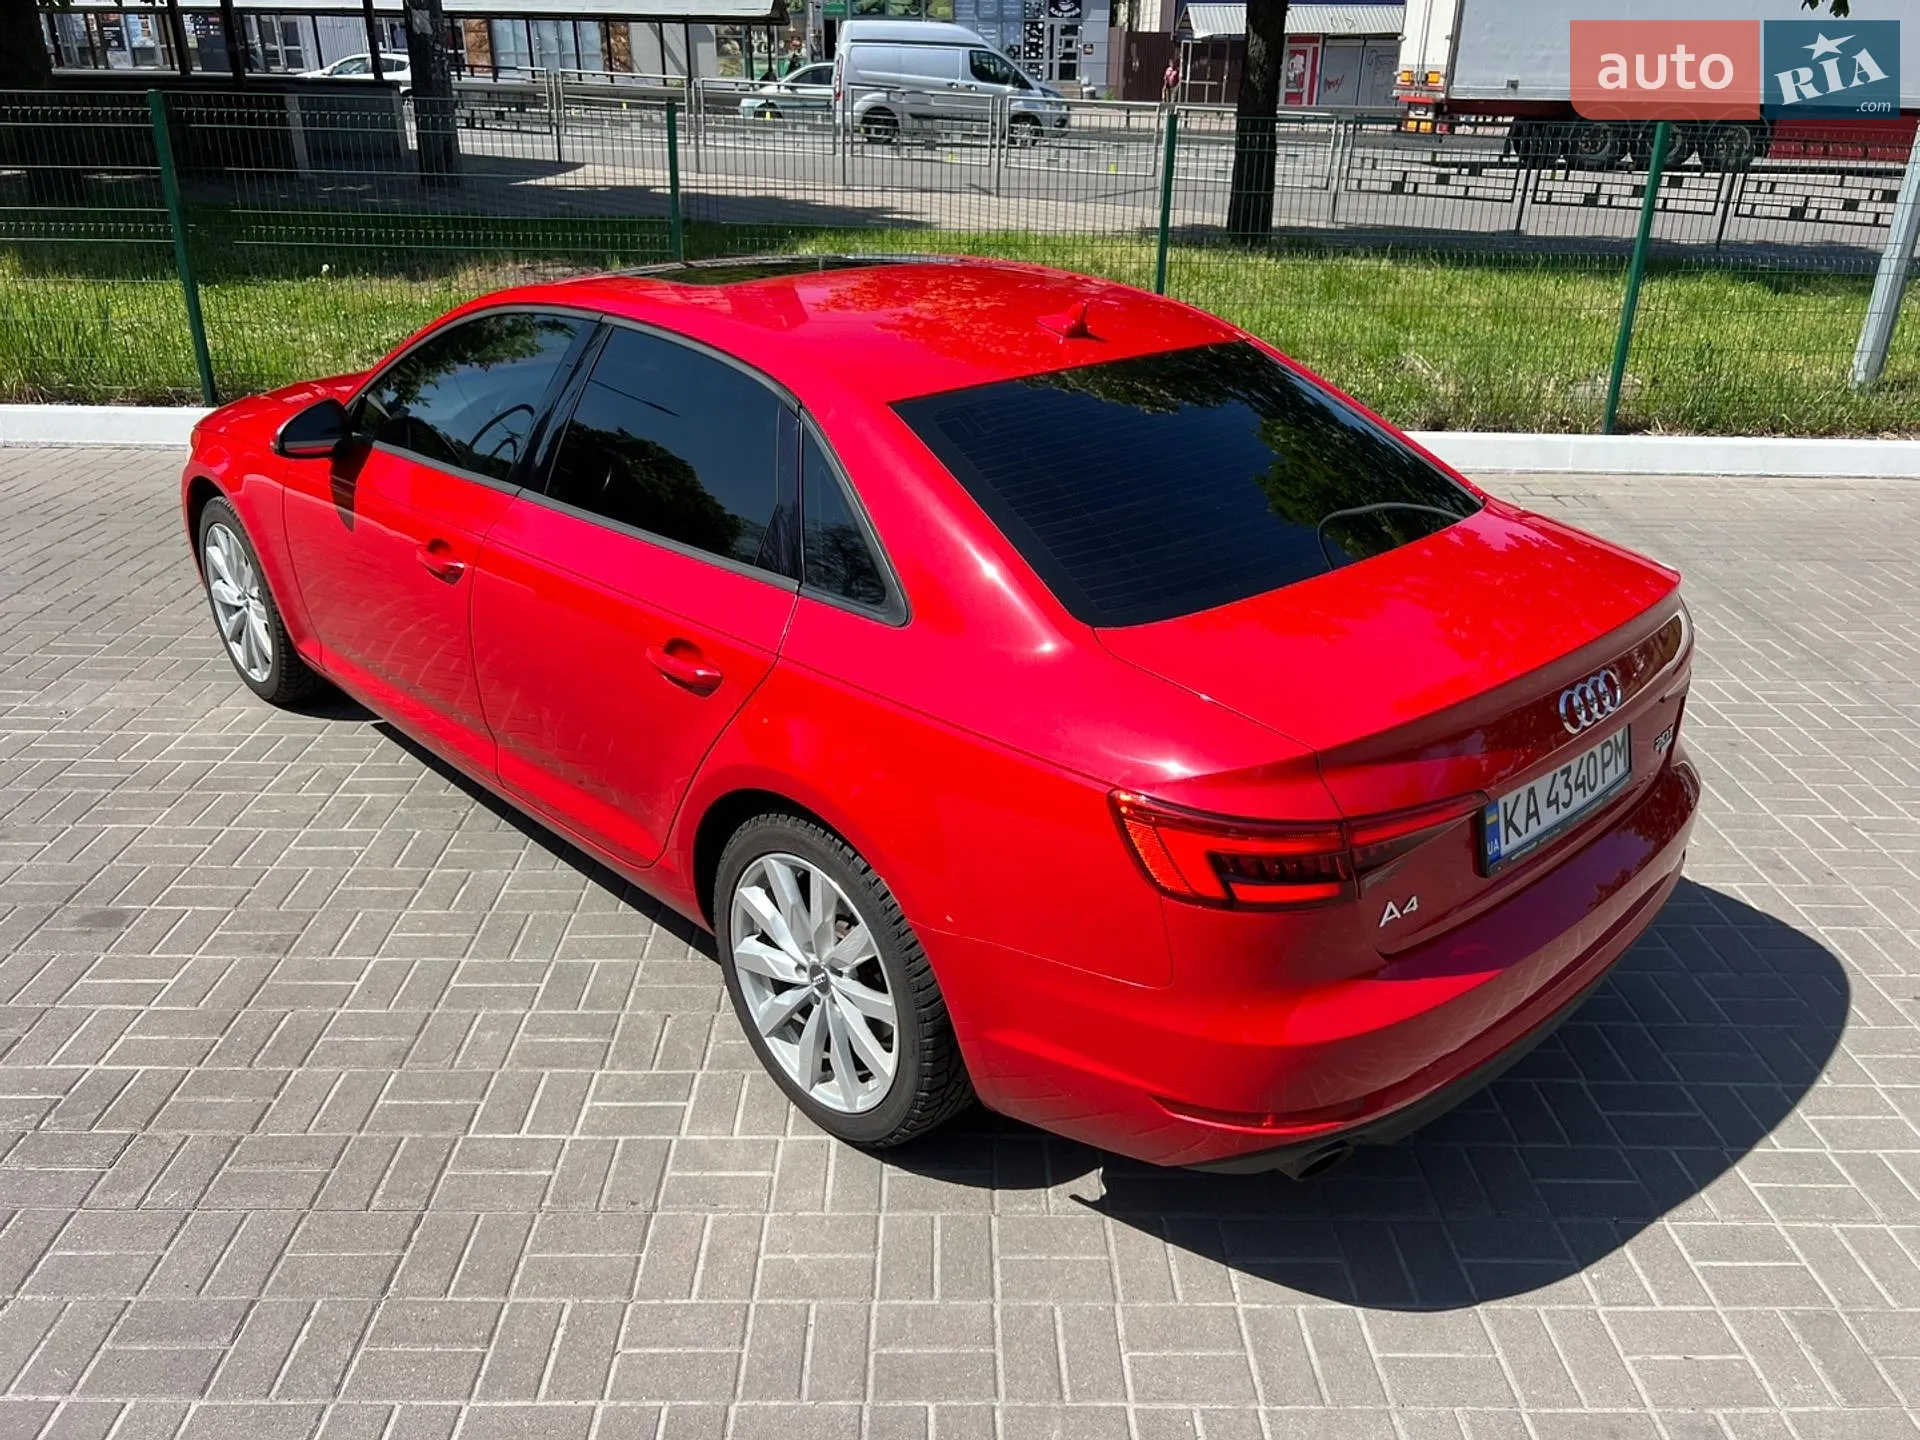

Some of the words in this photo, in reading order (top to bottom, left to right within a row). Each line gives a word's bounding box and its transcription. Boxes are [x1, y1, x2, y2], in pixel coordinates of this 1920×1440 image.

[1502, 786, 1542, 846] KA
[1546, 751, 1599, 815] 4340
[1601, 727, 1627, 785] PM
[1487, 838, 1500, 855] UA
[1379, 895, 1419, 928] A4
